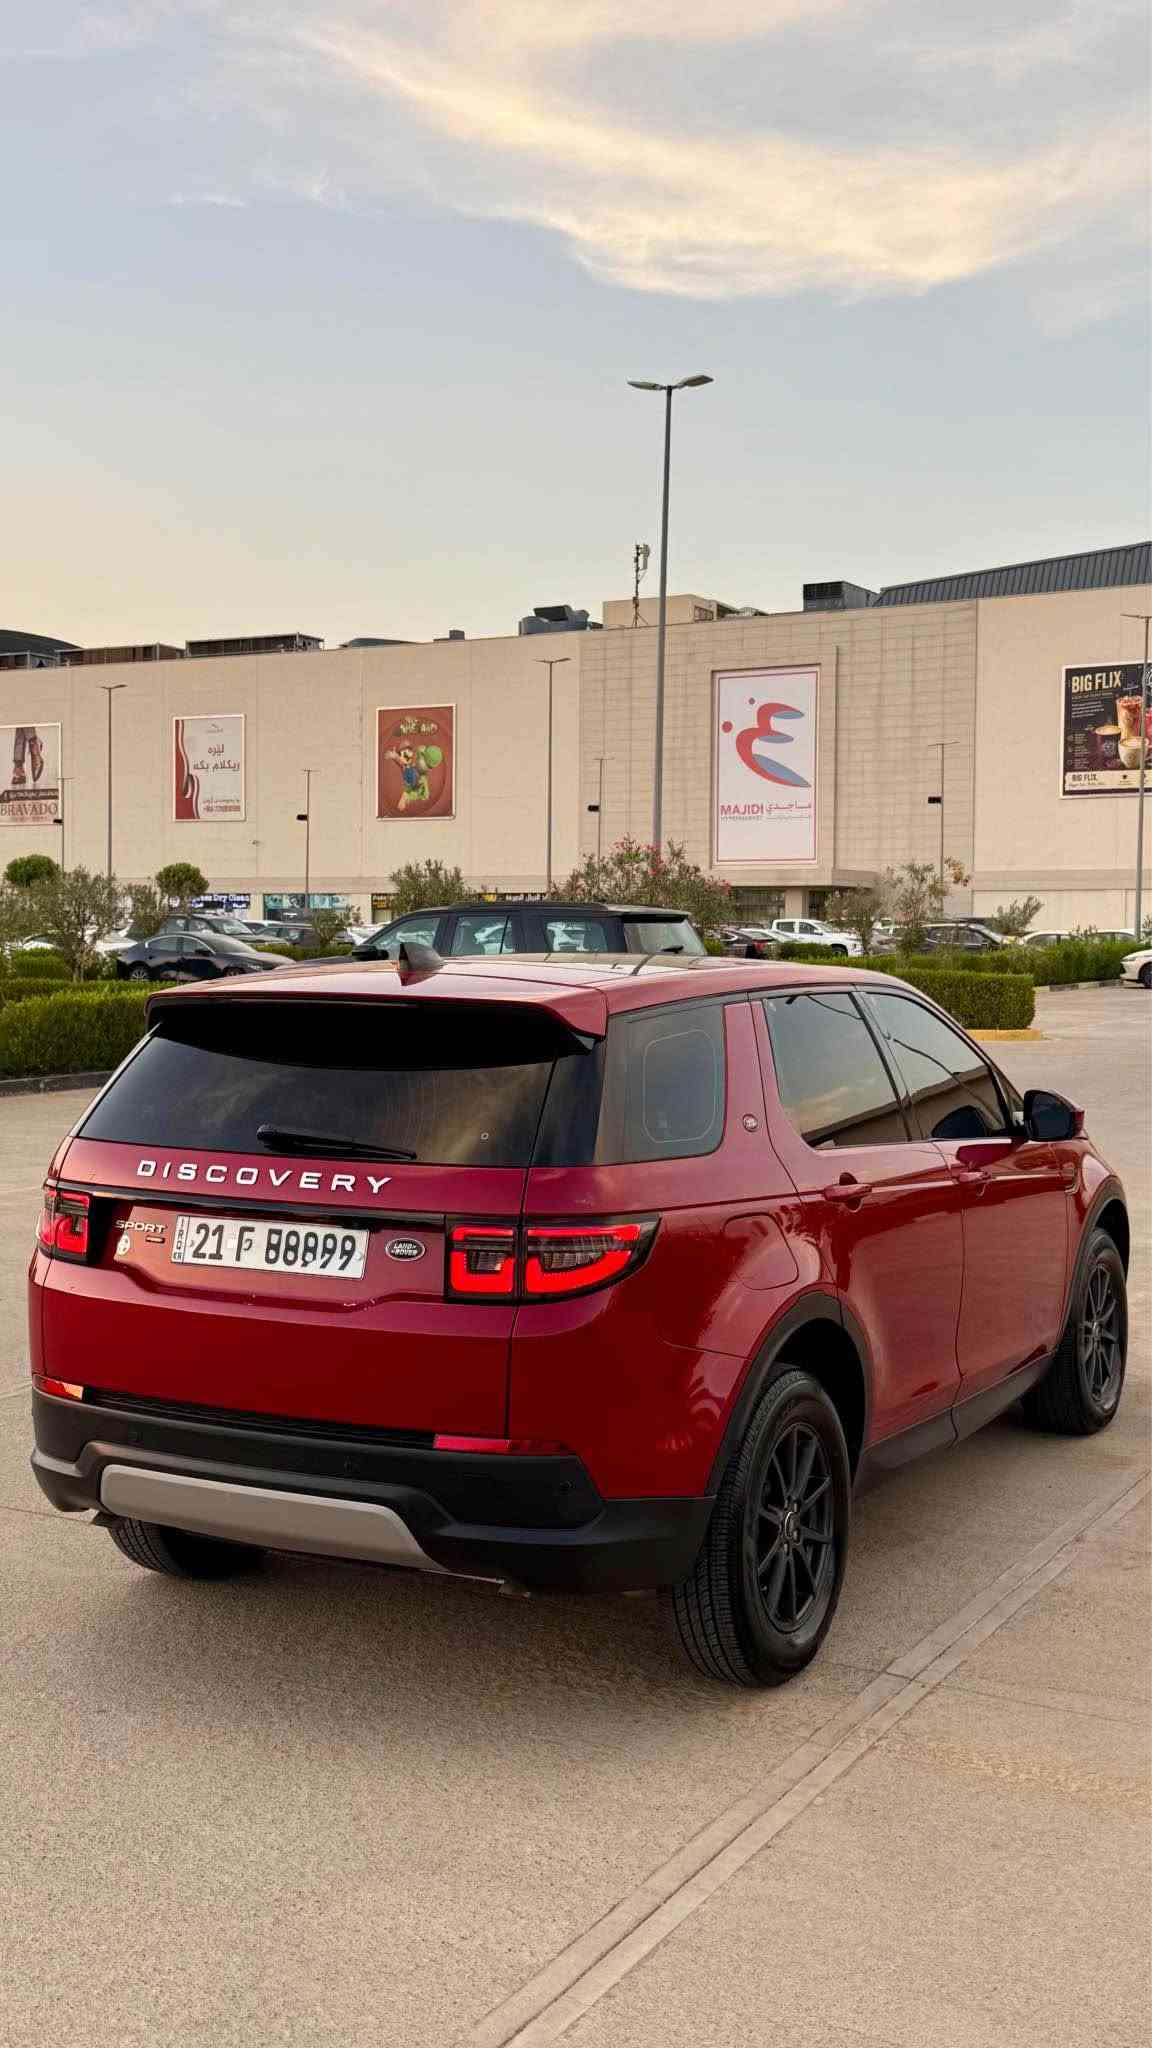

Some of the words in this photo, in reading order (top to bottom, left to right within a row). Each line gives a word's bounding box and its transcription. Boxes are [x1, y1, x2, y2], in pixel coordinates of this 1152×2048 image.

[1071, 674, 1092, 693] BIG
[1095, 670, 1122, 690] FLIX
[0, 802, 58, 817] BRAVADO
[720, 804, 764, 815] MAJIDI
[136, 1159, 392, 1195] DISCOVERY
[115, 1219, 166, 1233] SPORT
[192, 1223, 225, 1260] 21
